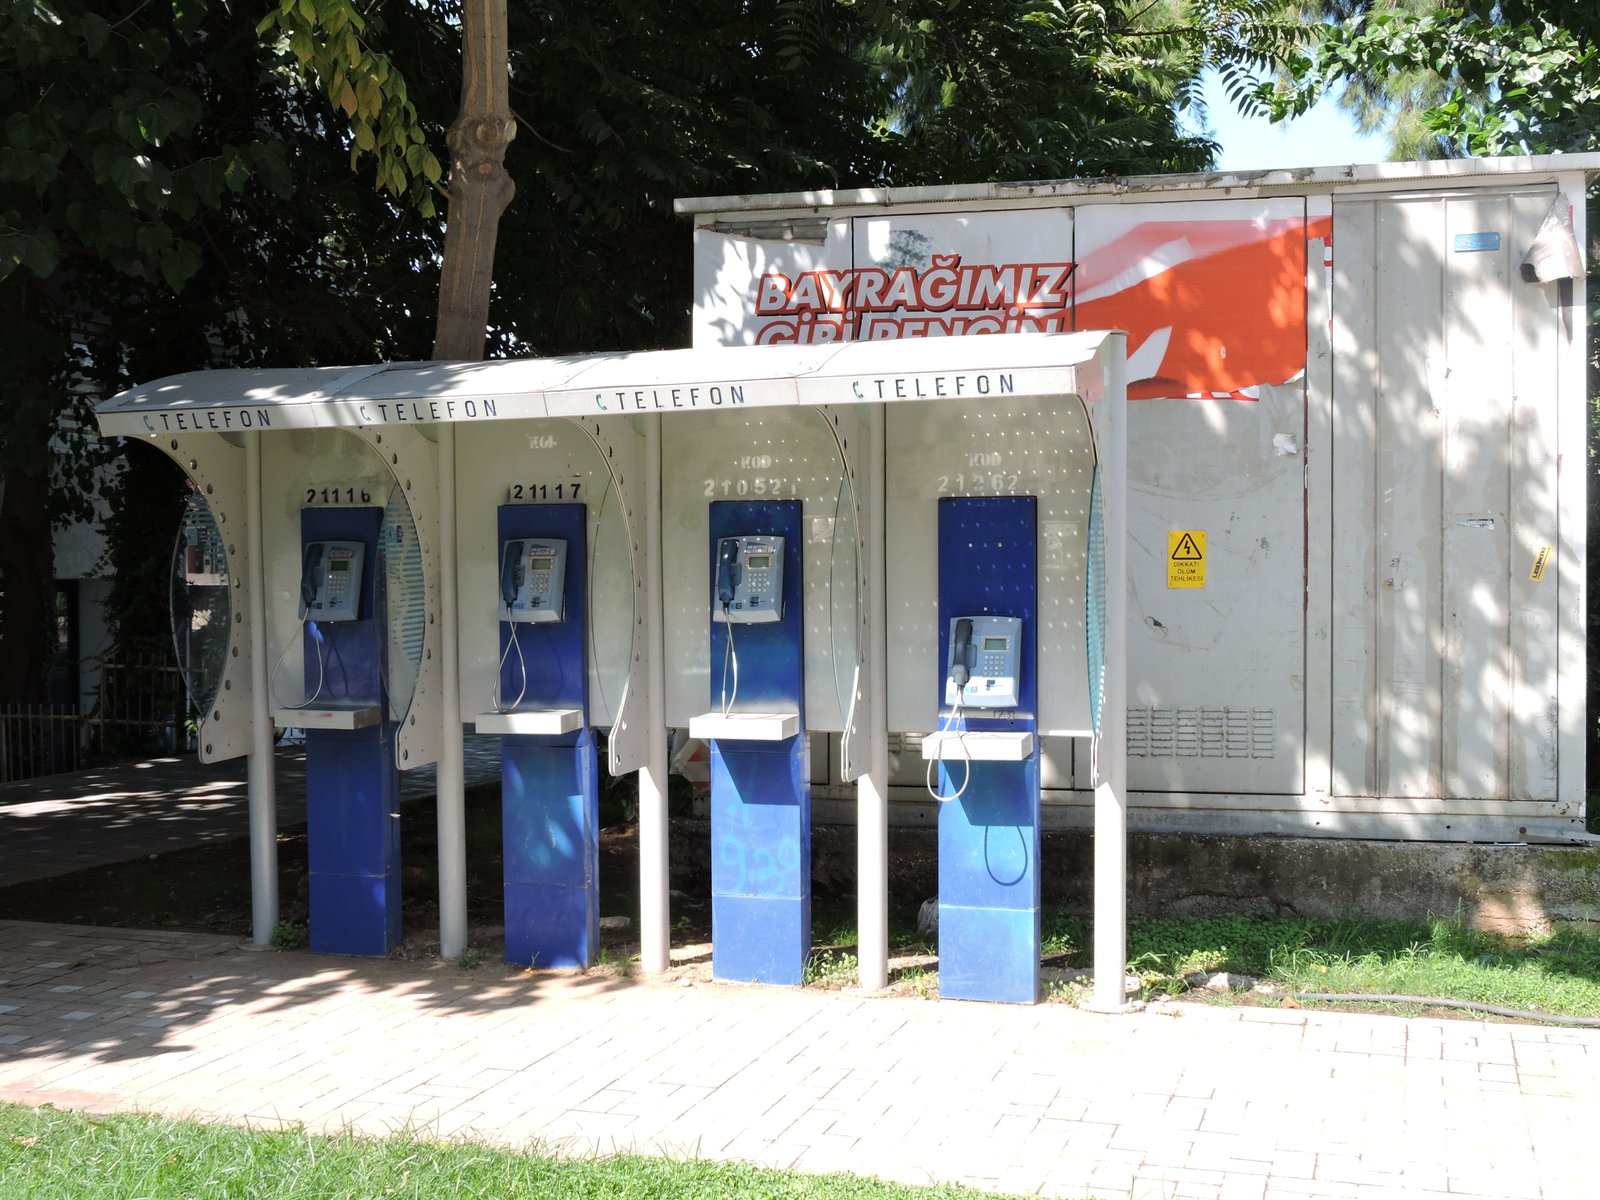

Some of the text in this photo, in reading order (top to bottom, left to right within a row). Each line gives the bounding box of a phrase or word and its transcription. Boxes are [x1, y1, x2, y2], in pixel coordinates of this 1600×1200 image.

[756, 253, 1072, 316] BAYRAĞIMIZ
[615, 385, 745, 410] TELEFON
[874, 374, 1014, 399] TELEFON
[159, 409, 271, 431] TELEFON
[377, 399, 497, 421] TELEFON
[306, 487, 371, 504] 21116
[513, 483, 581, 500] 21117
